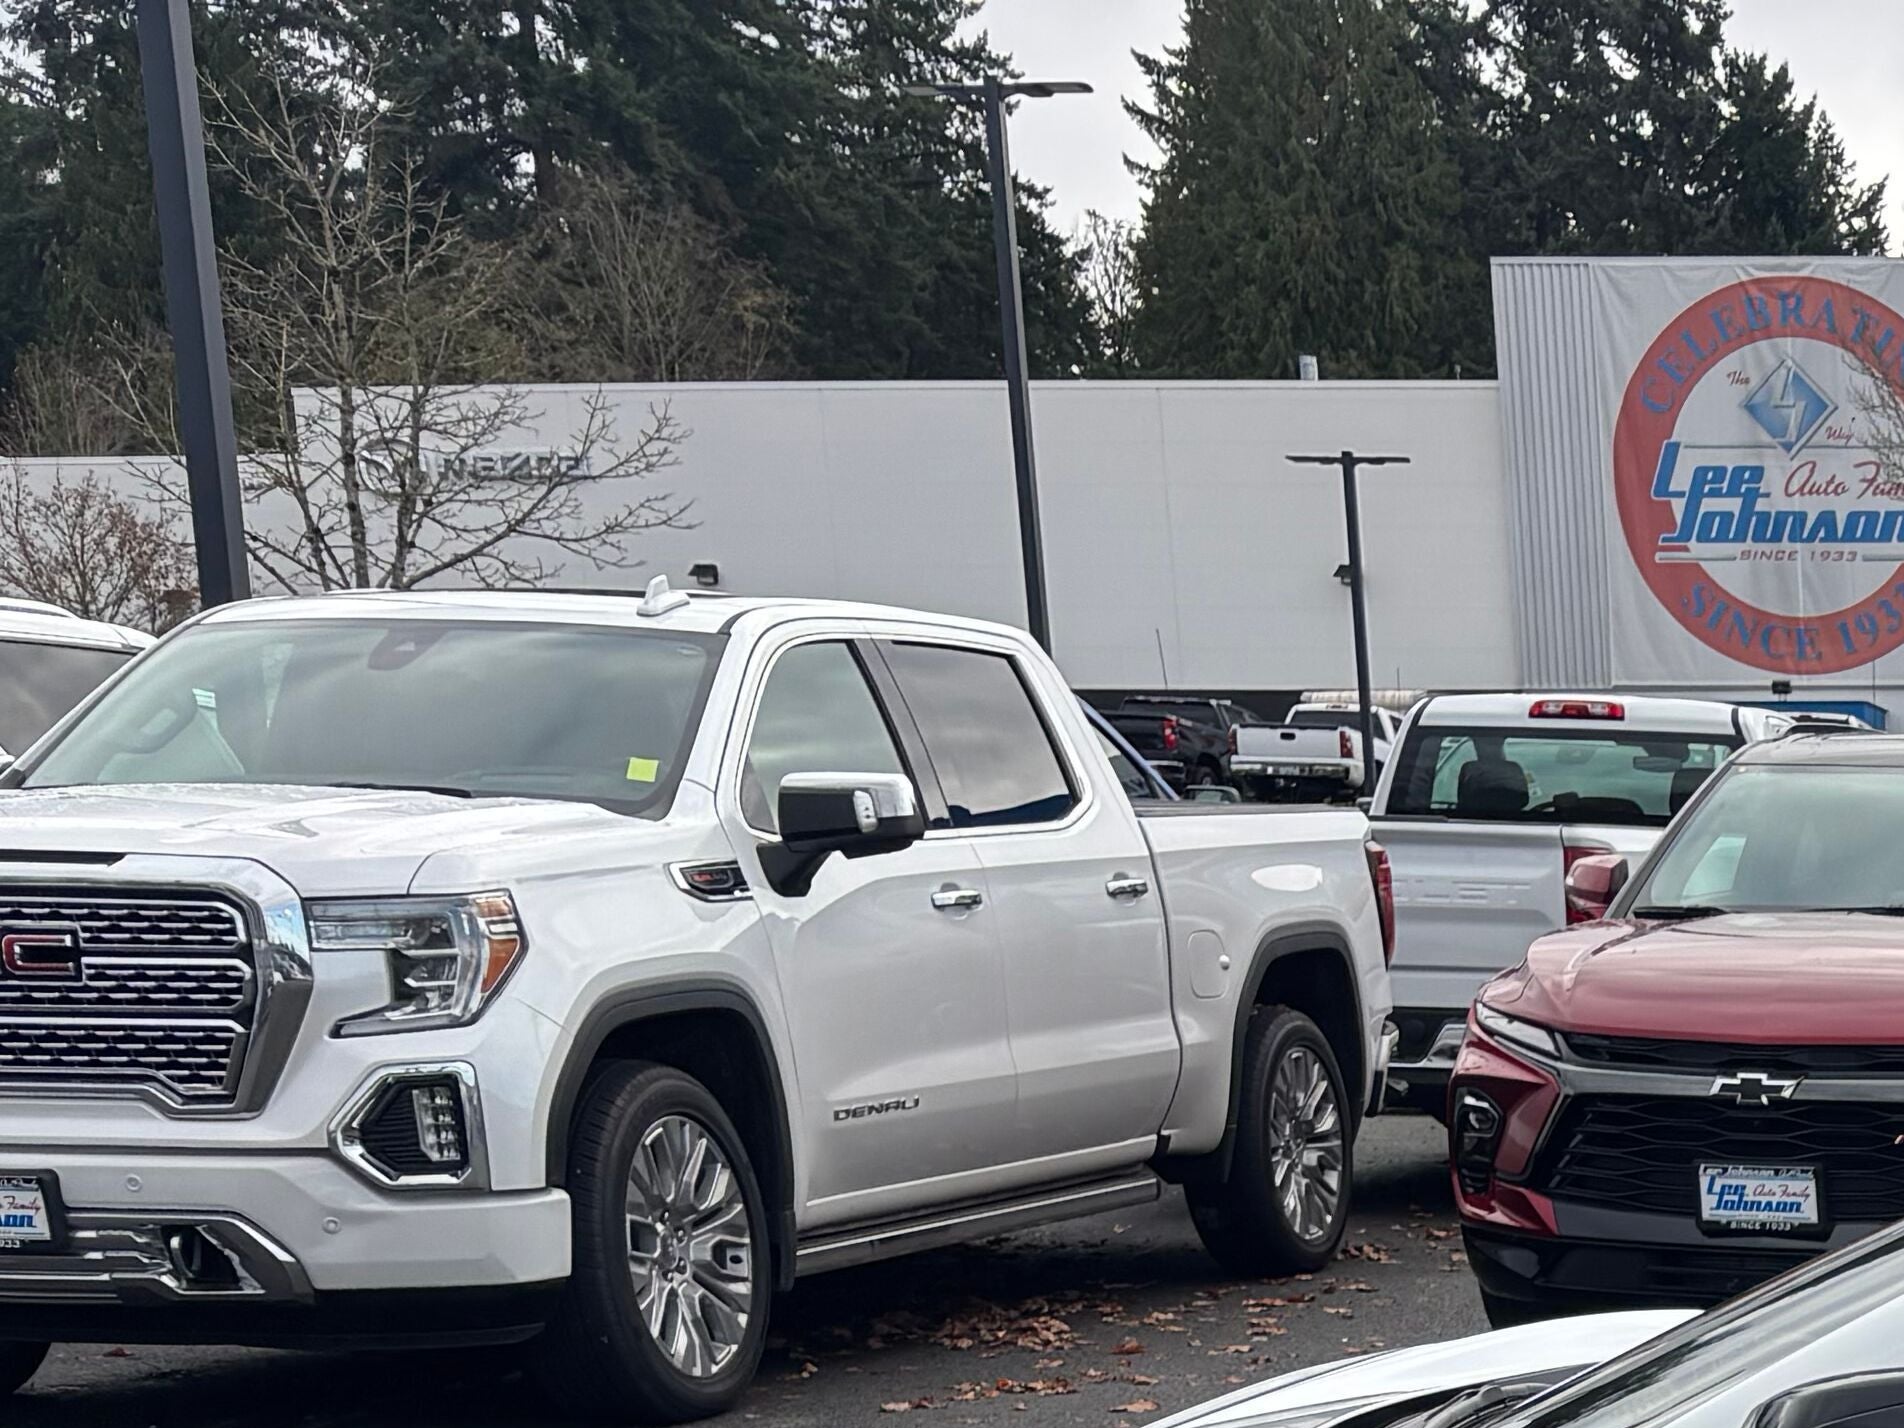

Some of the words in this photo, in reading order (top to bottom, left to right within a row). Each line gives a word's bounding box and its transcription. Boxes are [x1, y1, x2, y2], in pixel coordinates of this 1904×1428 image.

[1726, 371, 1751, 386] The
[1652, 441, 1772, 498] Lee
[1784, 461, 1849, 498] Auto
[1739, 550, 1798, 563] SINCE
[1810, 550, 1857, 563] 1933
[1682, 581, 1823, 662] SINCE
[1706, 1174, 1747, 1196] Lee
[1709, 1193, 1804, 1213] Johnson
